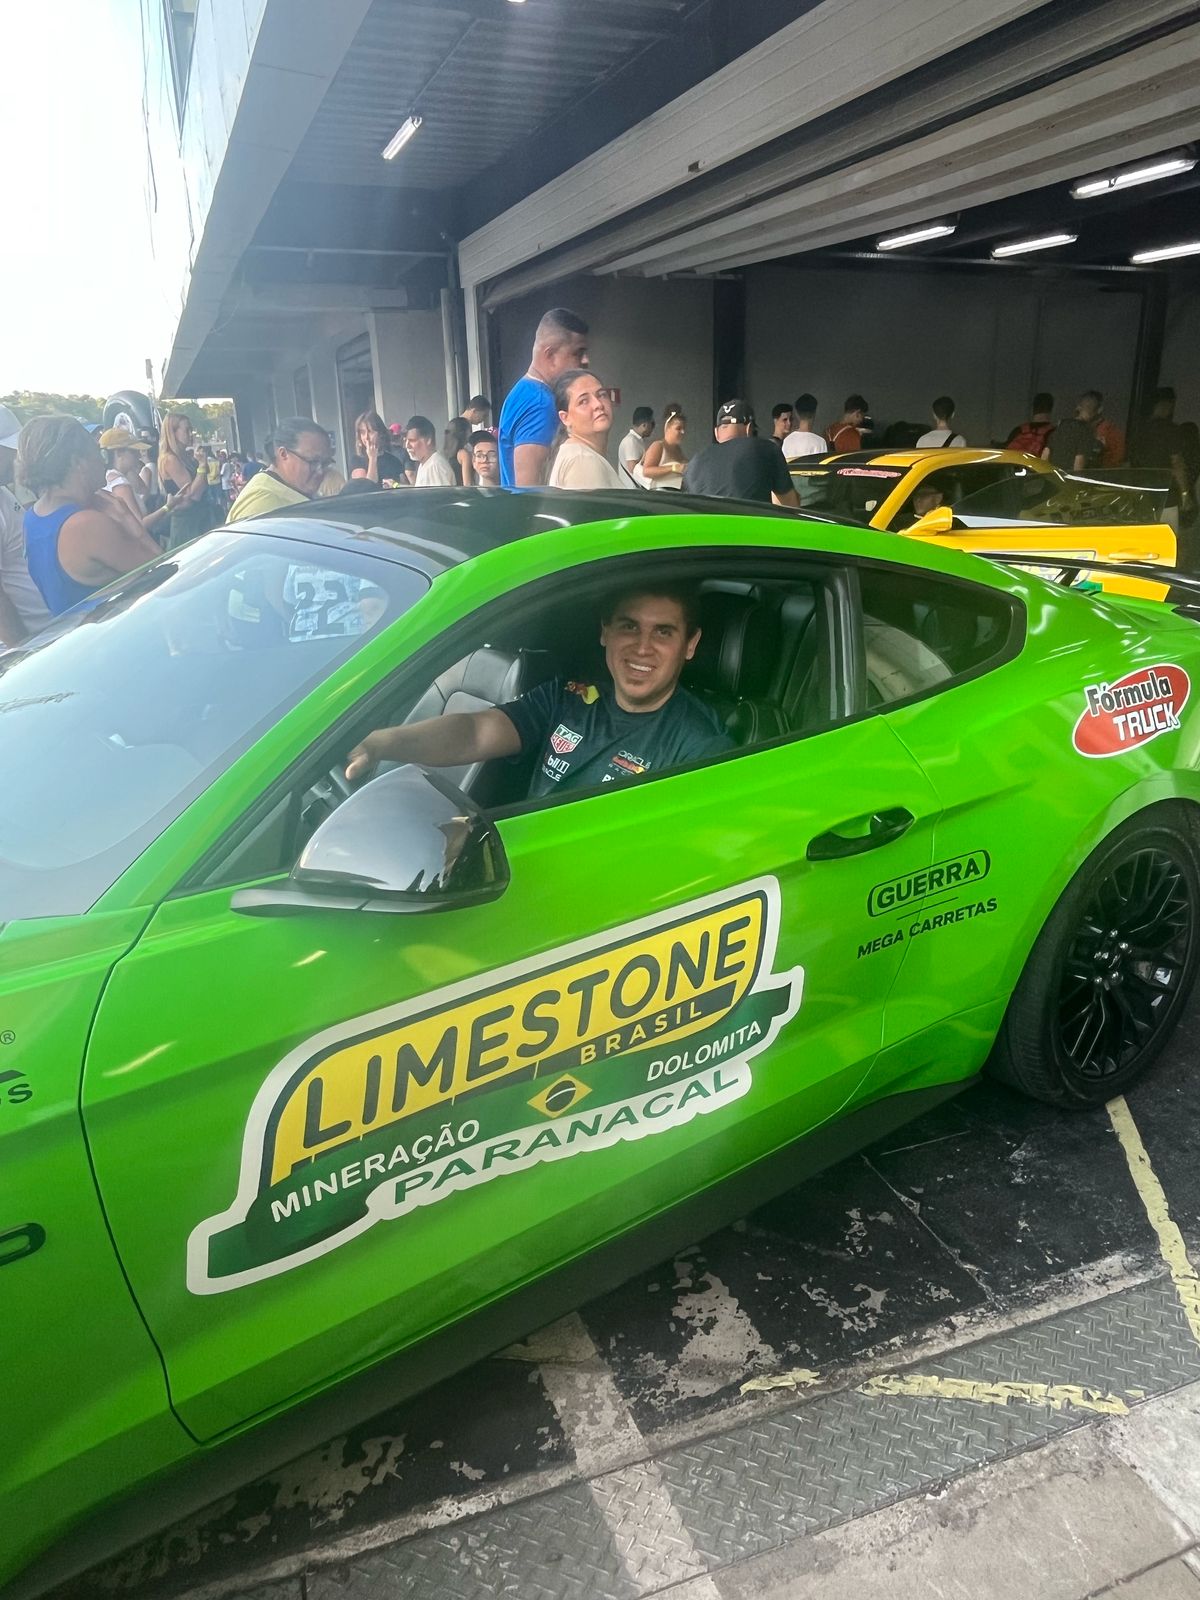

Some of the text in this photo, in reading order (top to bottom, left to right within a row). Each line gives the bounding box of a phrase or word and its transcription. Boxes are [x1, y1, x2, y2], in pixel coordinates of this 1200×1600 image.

[1086, 671, 1171, 716] Fórmula
[1113, 702, 1178, 740] TRUCK
[552, 735, 575, 752] HEUER
[559, 727, 580, 744] TAG
[618, 750, 652, 769] ORACLE
[877, 857, 980, 909] GUERRA
[857, 897, 998, 959] MEGA CARRETAS
[302, 915, 752, 1150] LIMESTONE
[580, 1001, 703, 1065] BRASIL
[645, 1019, 762, 1082] DOLOMITA
[393, 1069, 740, 1205] PARANACAL
[270, 1118, 481, 1223] MINERAÇÃO
